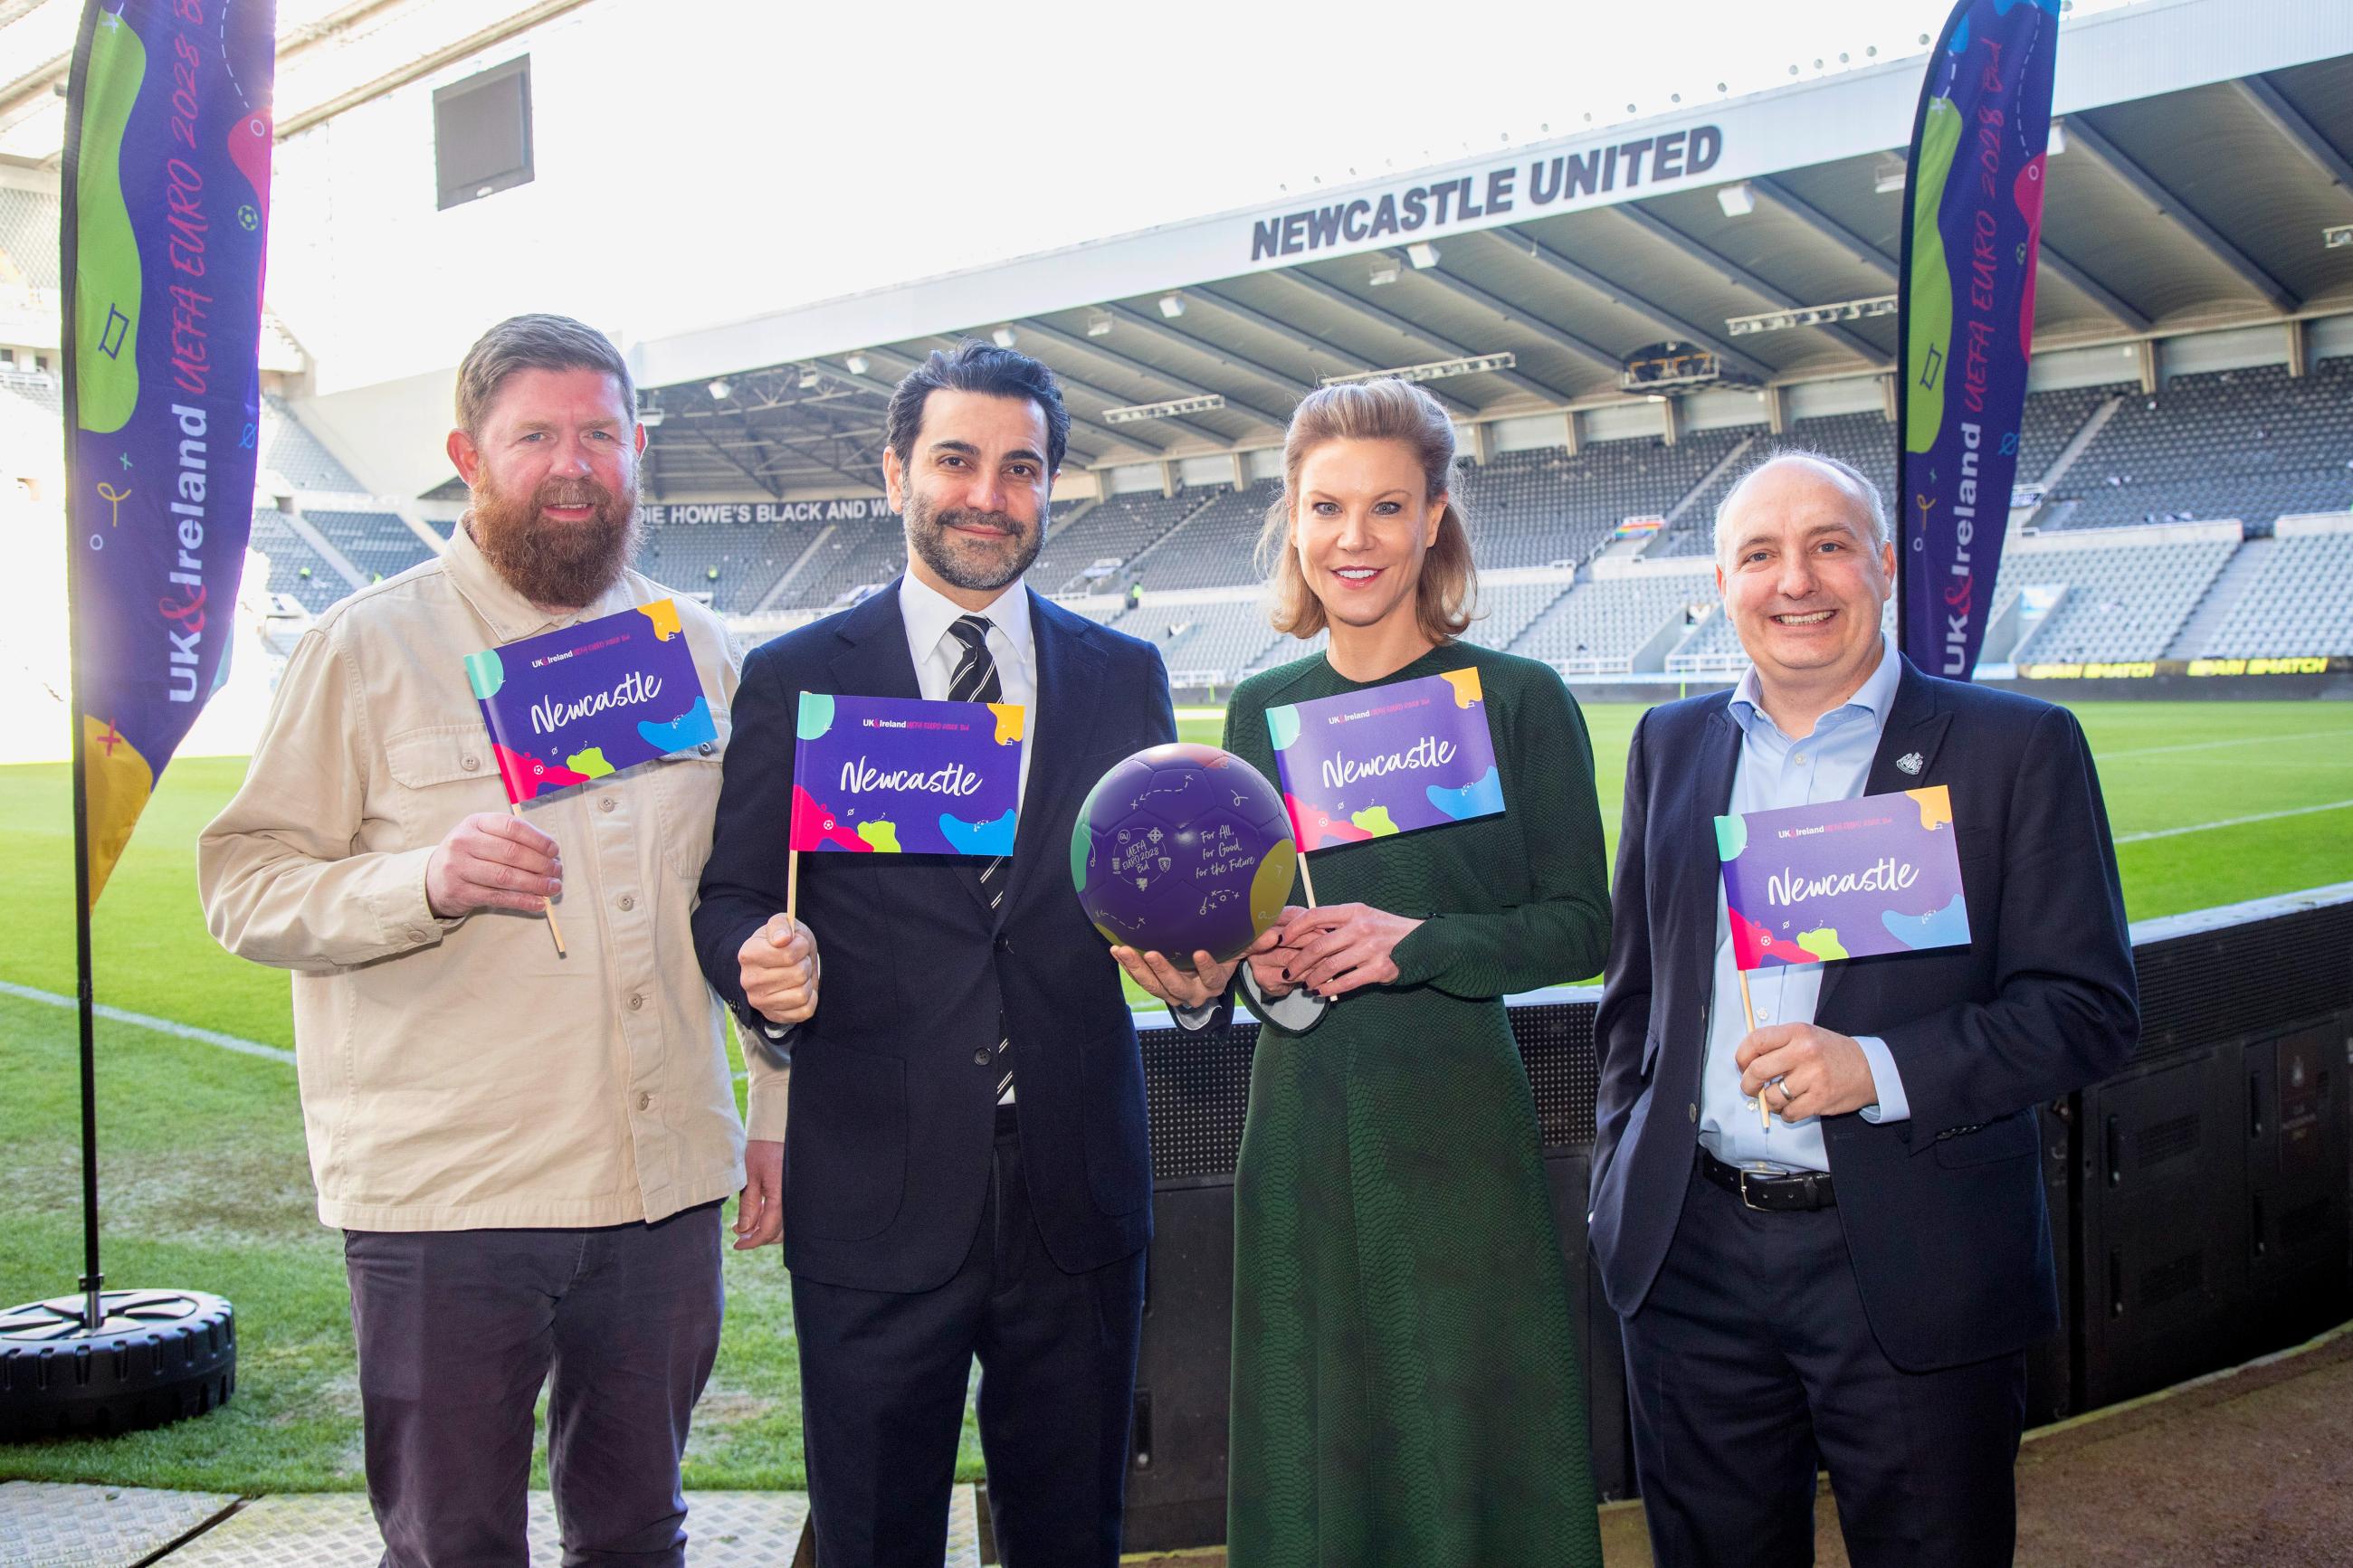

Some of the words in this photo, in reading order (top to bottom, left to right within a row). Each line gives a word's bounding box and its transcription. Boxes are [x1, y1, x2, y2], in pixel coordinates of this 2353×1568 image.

[171, 31, 199, 149] 2028
[1978, 105, 2004, 198] 2028
[167, 158, 208, 276] EURO
[1251, 167, 1517, 261] NEWCASTLE
[1529, 125, 1721, 204] UNITED
[1971, 210, 1997, 310] EURO
[168, 285, 213, 394] UEFA
[1964, 320, 1995, 413] UEFA
[671, 505, 750, 524] HOWE'S
[757, 502, 823, 522] BLACK
[826, 499, 866, 519] AND
[158, 404, 207, 702] UK&Ireland
[1943, 423, 1981, 675] UK&Ireland
[530, 671, 662, 735] Newcastle
[840, 755, 983, 796] Newcastle
[1322, 736, 1457, 788] Newcastle
[1122, 854, 1140, 870] EURO
[1140, 846, 1159, 861] 2028
[1126, 840, 1148, 858] UEFA
[1196, 867, 1208, 879] for
[1210, 862, 1227, 876] the
[1229, 856, 1255, 871] Future
[1200, 831, 1215, 844] For
[1203, 848, 1215, 860] for
[1767, 857, 1920, 906] Newcastle
